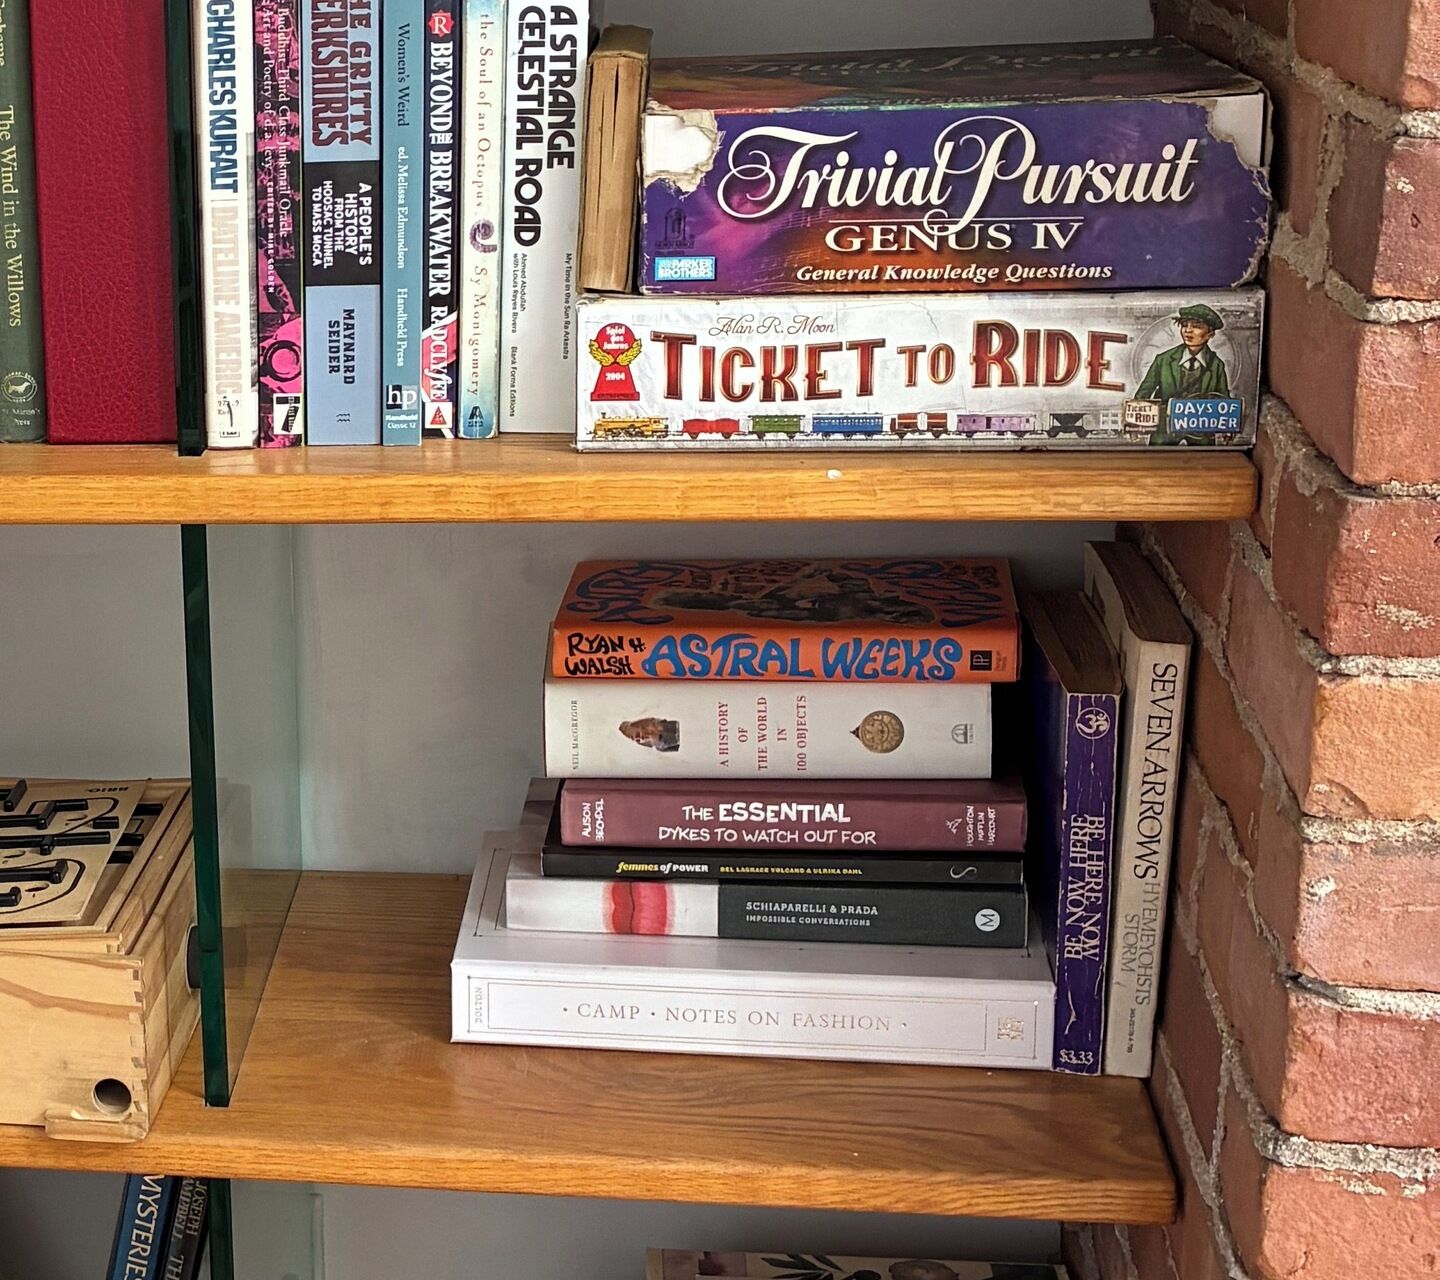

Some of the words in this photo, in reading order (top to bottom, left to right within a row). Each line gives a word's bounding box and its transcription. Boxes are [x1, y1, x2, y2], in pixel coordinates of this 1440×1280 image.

[551, 6, 577, 26] A
[348, 42, 373, 146] GRITTY
[430, 41, 454, 133] BEYOND
[515, 6, 546, 152] CELESTIAL
[547, 34, 577, 169] STRANGE
[208, 109, 239, 194] KURALT
[429, 133, 453, 144] THE
[0, 145, 18, 195] Wind
[359, 183, 373, 194] A
[717, 126, 953, 218] Trivial
[935, 115, 1198, 235] Pursuit
[3, 200, 15, 216] in
[344, 193, 359, 257] HISTORY
[429, 150, 454, 297] BREAKWATER
[514, 157, 543, 245] ROAD
[3, 220, 18, 246] the
[359, 196, 373, 266] PEOPLE'S
[825, 222, 1012, 252] GENUS
[1029, 222, 1084, 250] IV
[3, 255, 22, 327] Willows
[797, 264, 877, 282] General
[883, 263, 1000, 280] Knowledge
[1005, 262, 1111, 279] Questions
[328, 319, 340, 375] SEIDER
[342, 308, 355, 385] MAYNARD
[651, 330, 885, 403] TICKET
[898, 346, 955, 387] TO
[972, 320, 1129, 391] RIDE
[1174, 416, 1238, 429] WONDER
[1175, 401, 1213, 415] DAYS
[1218, 403, 1238, 414] OF
[642, 631, 819, 680] ASTRAL
[822, 636, 963, 682] WEEKS
[1152, 662, 1178, 759] SEVEN
[659, 827, 715, 844] DYKES
[717, 827, 740, 844] TO
[741, 828, 799, 845] WATCH
[804, 830, 837, 845] OUT
[841, 830, 877, 845] FOR
[682, 805, 714, 822] THE
[718, 801, 851, 824] ESSENTIAL
[1134, 761, 1176, 880] ARROWS
[746, 902, 826, 913] SCHIAPARELLI
[830, 905, 837, 913] &
[841, 905, 878, 915] PRADA
[577, 1003, 641, 1020] CAMP
[665, 1005, 739, 1025] NOTES
[749, 1009, 781, 1027] ON
[794, 1010, 891, 1032] FASHION
